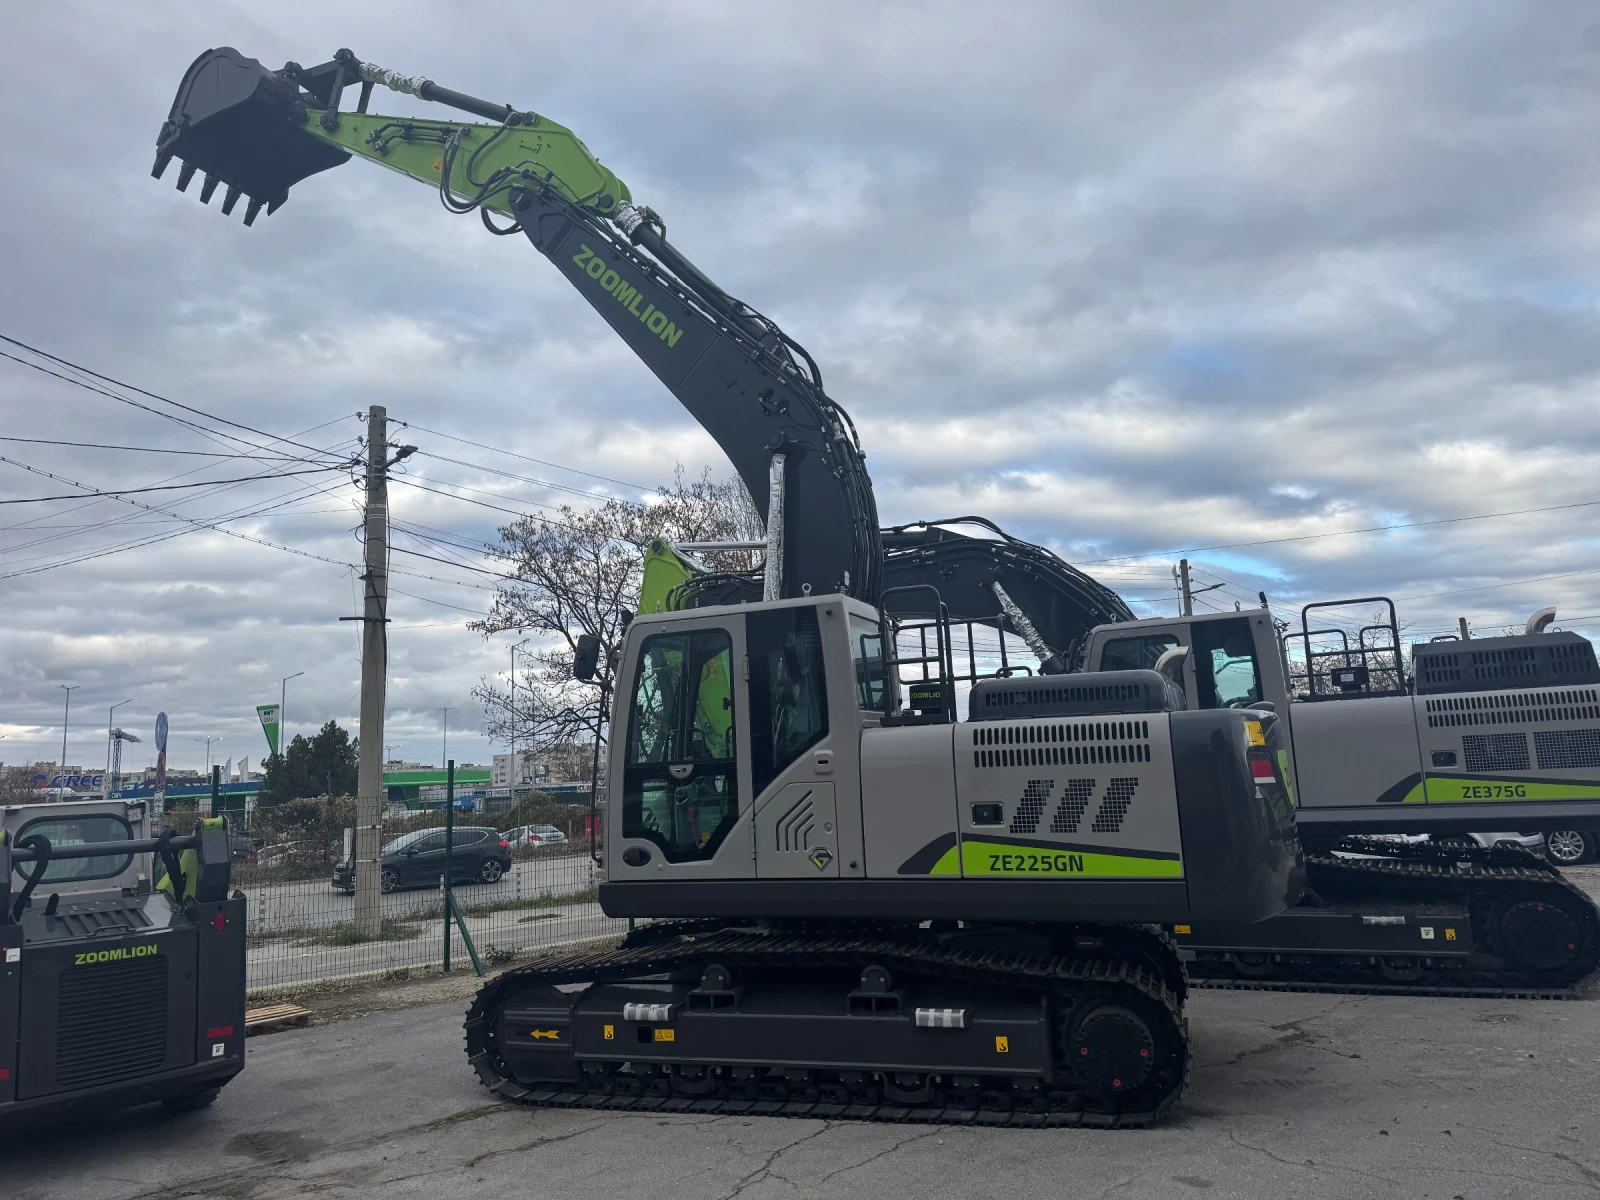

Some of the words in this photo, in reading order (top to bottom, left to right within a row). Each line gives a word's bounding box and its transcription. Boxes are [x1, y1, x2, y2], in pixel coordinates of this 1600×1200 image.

[572, 244, 684, 348] ZOOMLION
[51, 775, 104, 787] GREE
[1461, 785, 1527, 799] ZE375G
[988, 854, 1085, 872] ZE225GN
[75, 944, 157, 965] ZOOMLION
